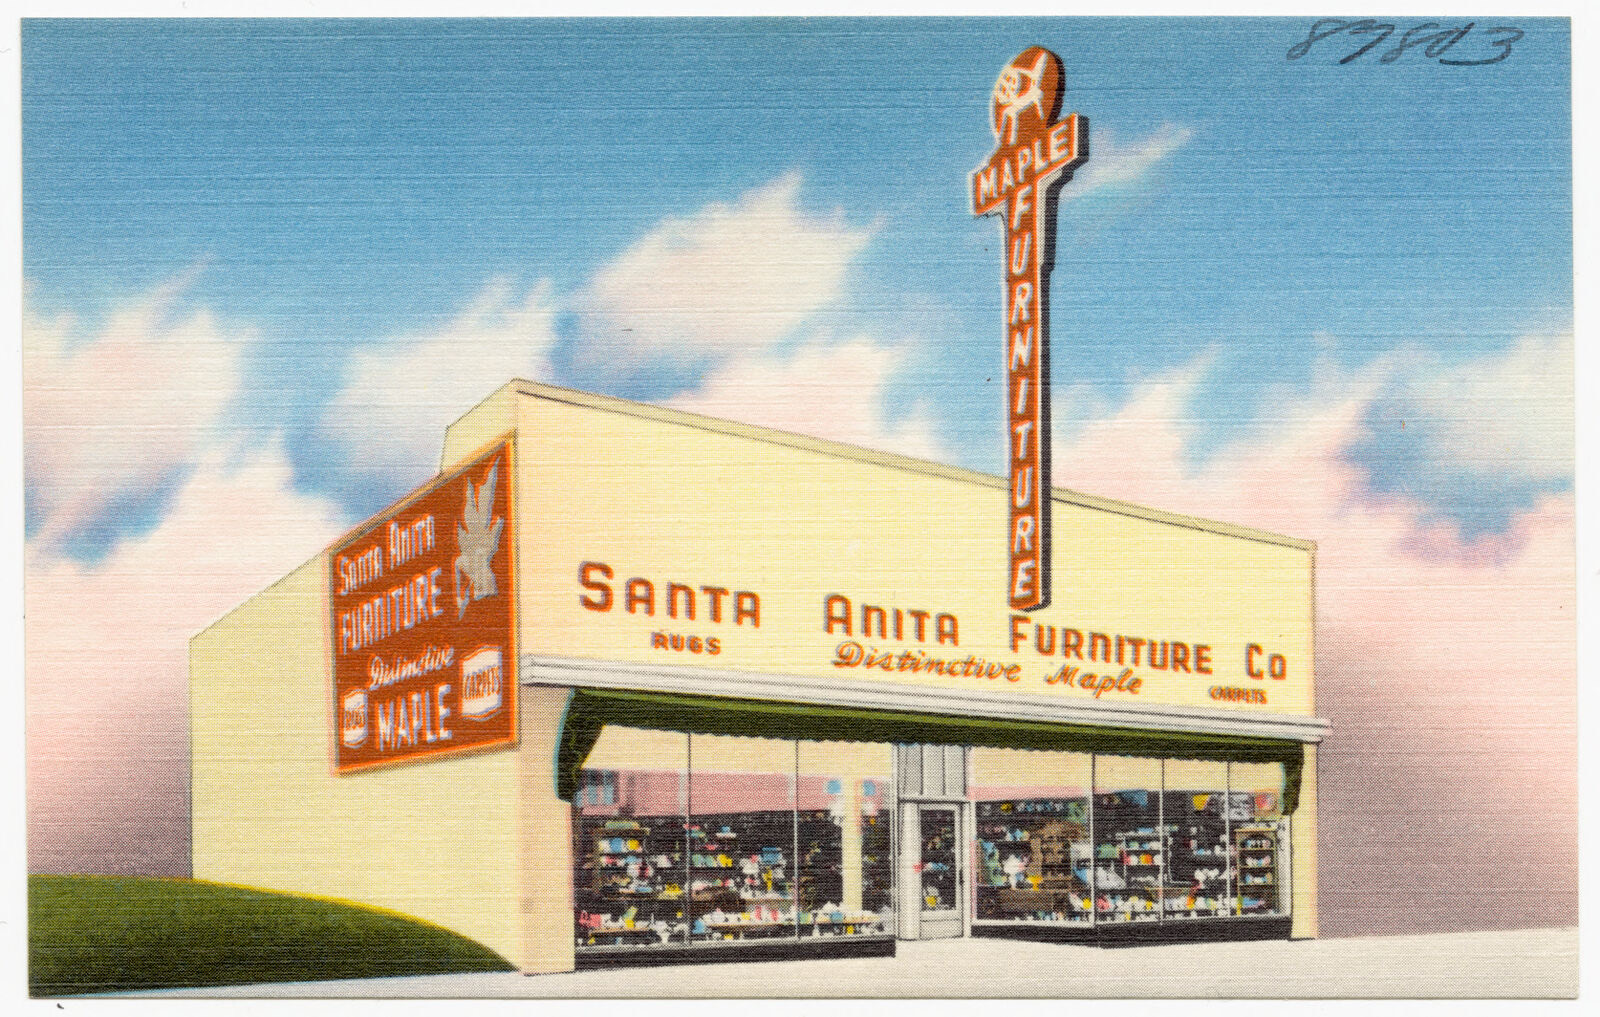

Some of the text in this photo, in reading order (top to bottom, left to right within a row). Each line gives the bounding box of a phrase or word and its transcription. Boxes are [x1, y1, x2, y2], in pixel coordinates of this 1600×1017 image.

[978, 124, 1069, 206] MAPLE
[1011, 184, 1036, 599] FURNITURE
[340, 567, 445, 656] FURNITURE
[577, 560, 761, 628] SANTA
[823, 592, 960, 646] ANITA
[1009, 614, 1213, 675] FURNITURE
[651, 631, 722, 656] RUGS
[367, 645, 455, 691] Distinctive
[831, 640, 1144, 699] Distinctive Maple
[1208, 685, 1268, 705] CARPETS
[376, 683, 454, 752] MAPLE
